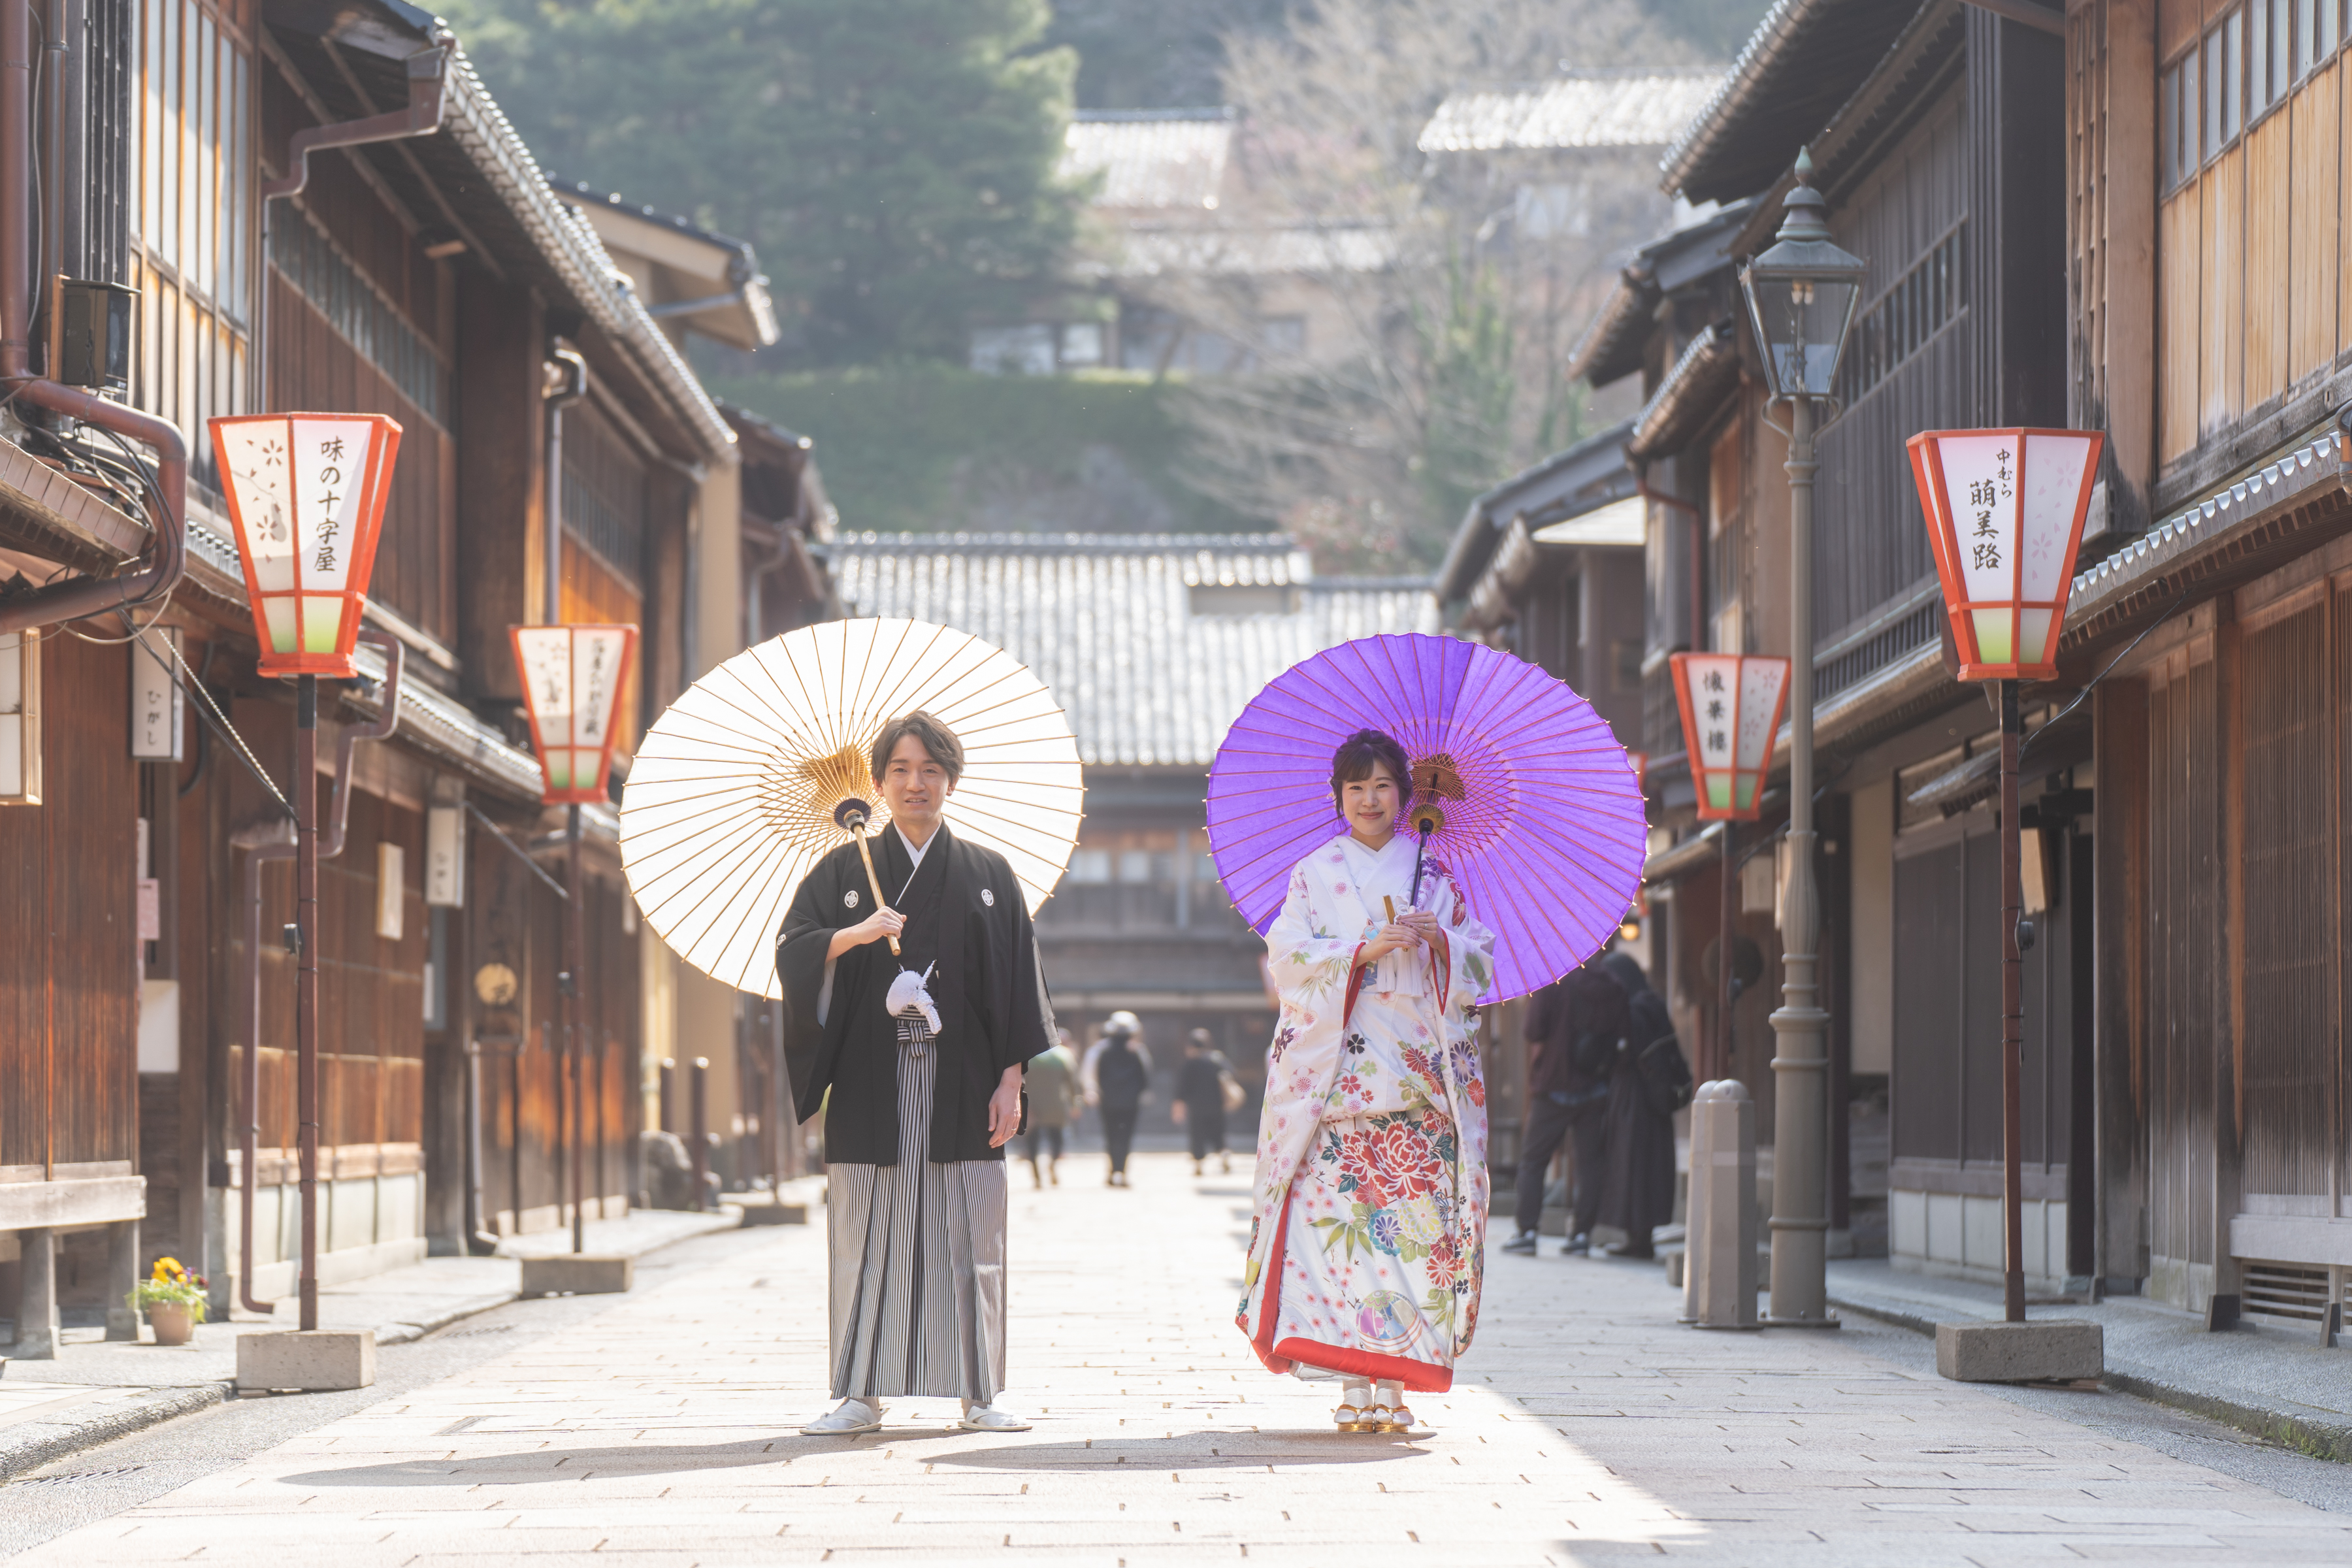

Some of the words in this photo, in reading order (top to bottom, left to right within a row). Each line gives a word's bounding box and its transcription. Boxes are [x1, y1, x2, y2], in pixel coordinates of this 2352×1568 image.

[314, 436, 344, 572] 味の十字屋
[1996, 448, 2012, 498] 中むら
[1970, 479, 2002, 571] 萌美路
[147, 690, 161, 745] ひがし
